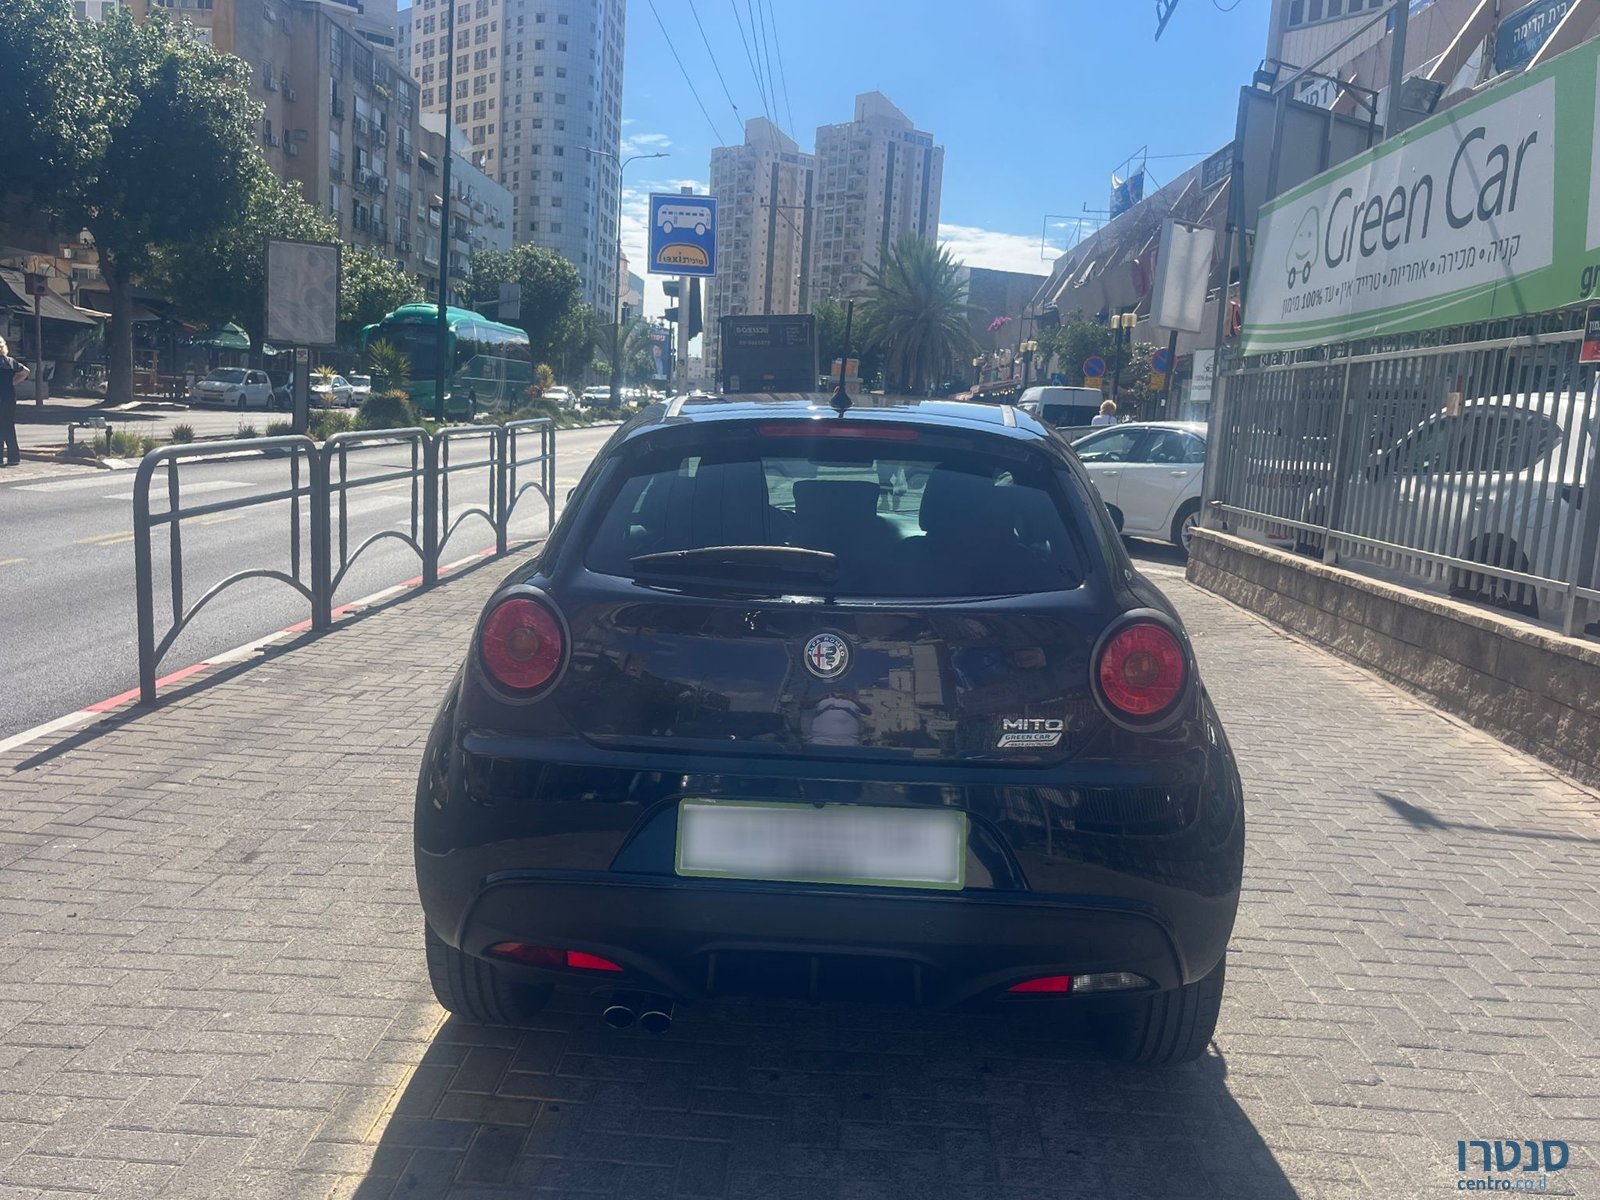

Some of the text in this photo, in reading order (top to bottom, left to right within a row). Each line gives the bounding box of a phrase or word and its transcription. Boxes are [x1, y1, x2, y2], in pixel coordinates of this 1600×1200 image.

[1324, 126, 1538, 269] Green Car
[1437, 246, 1476, 276] מכירה
[1487, 234, 1521, 266] קניה
[1387, 258, 1429, 288] אחריות
[824, 636, 845, 657] ROMEO
[1003, 718, 1063, 731] MITO
